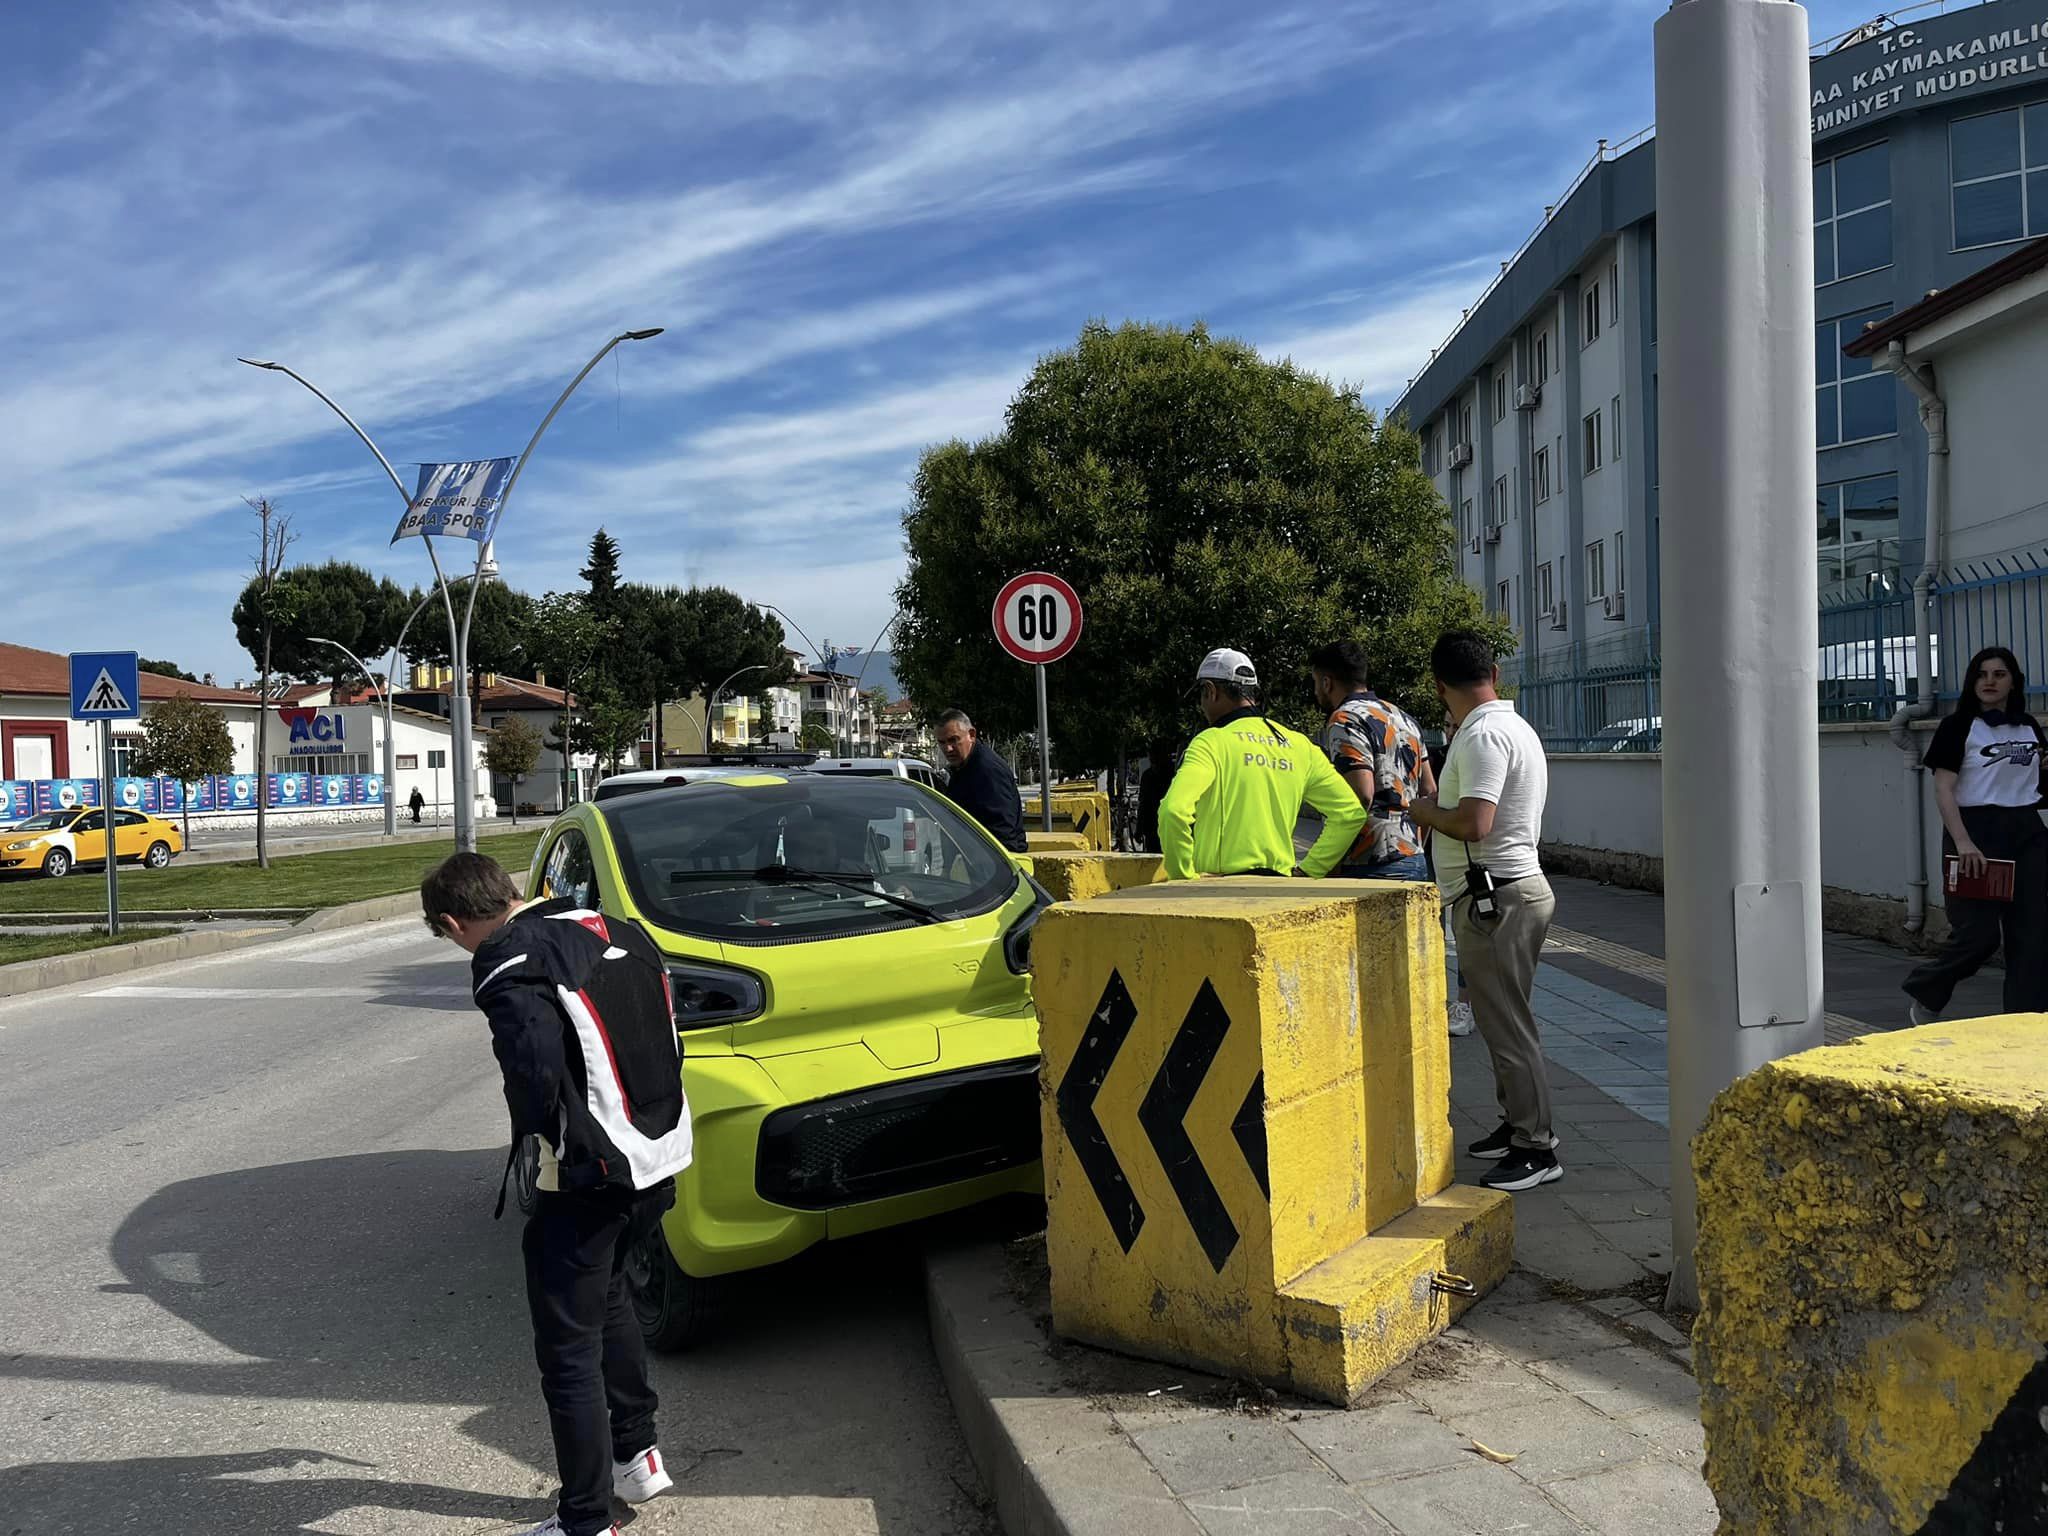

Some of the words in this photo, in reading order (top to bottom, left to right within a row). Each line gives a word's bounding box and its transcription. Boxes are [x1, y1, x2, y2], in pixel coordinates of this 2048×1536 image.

[1878, 30, 1924, 55] T.C.
[441, 513, 485, 530] SPOR
[1018, 594, 1057, 641] 60
[289, 713, 345, 743] ACI
